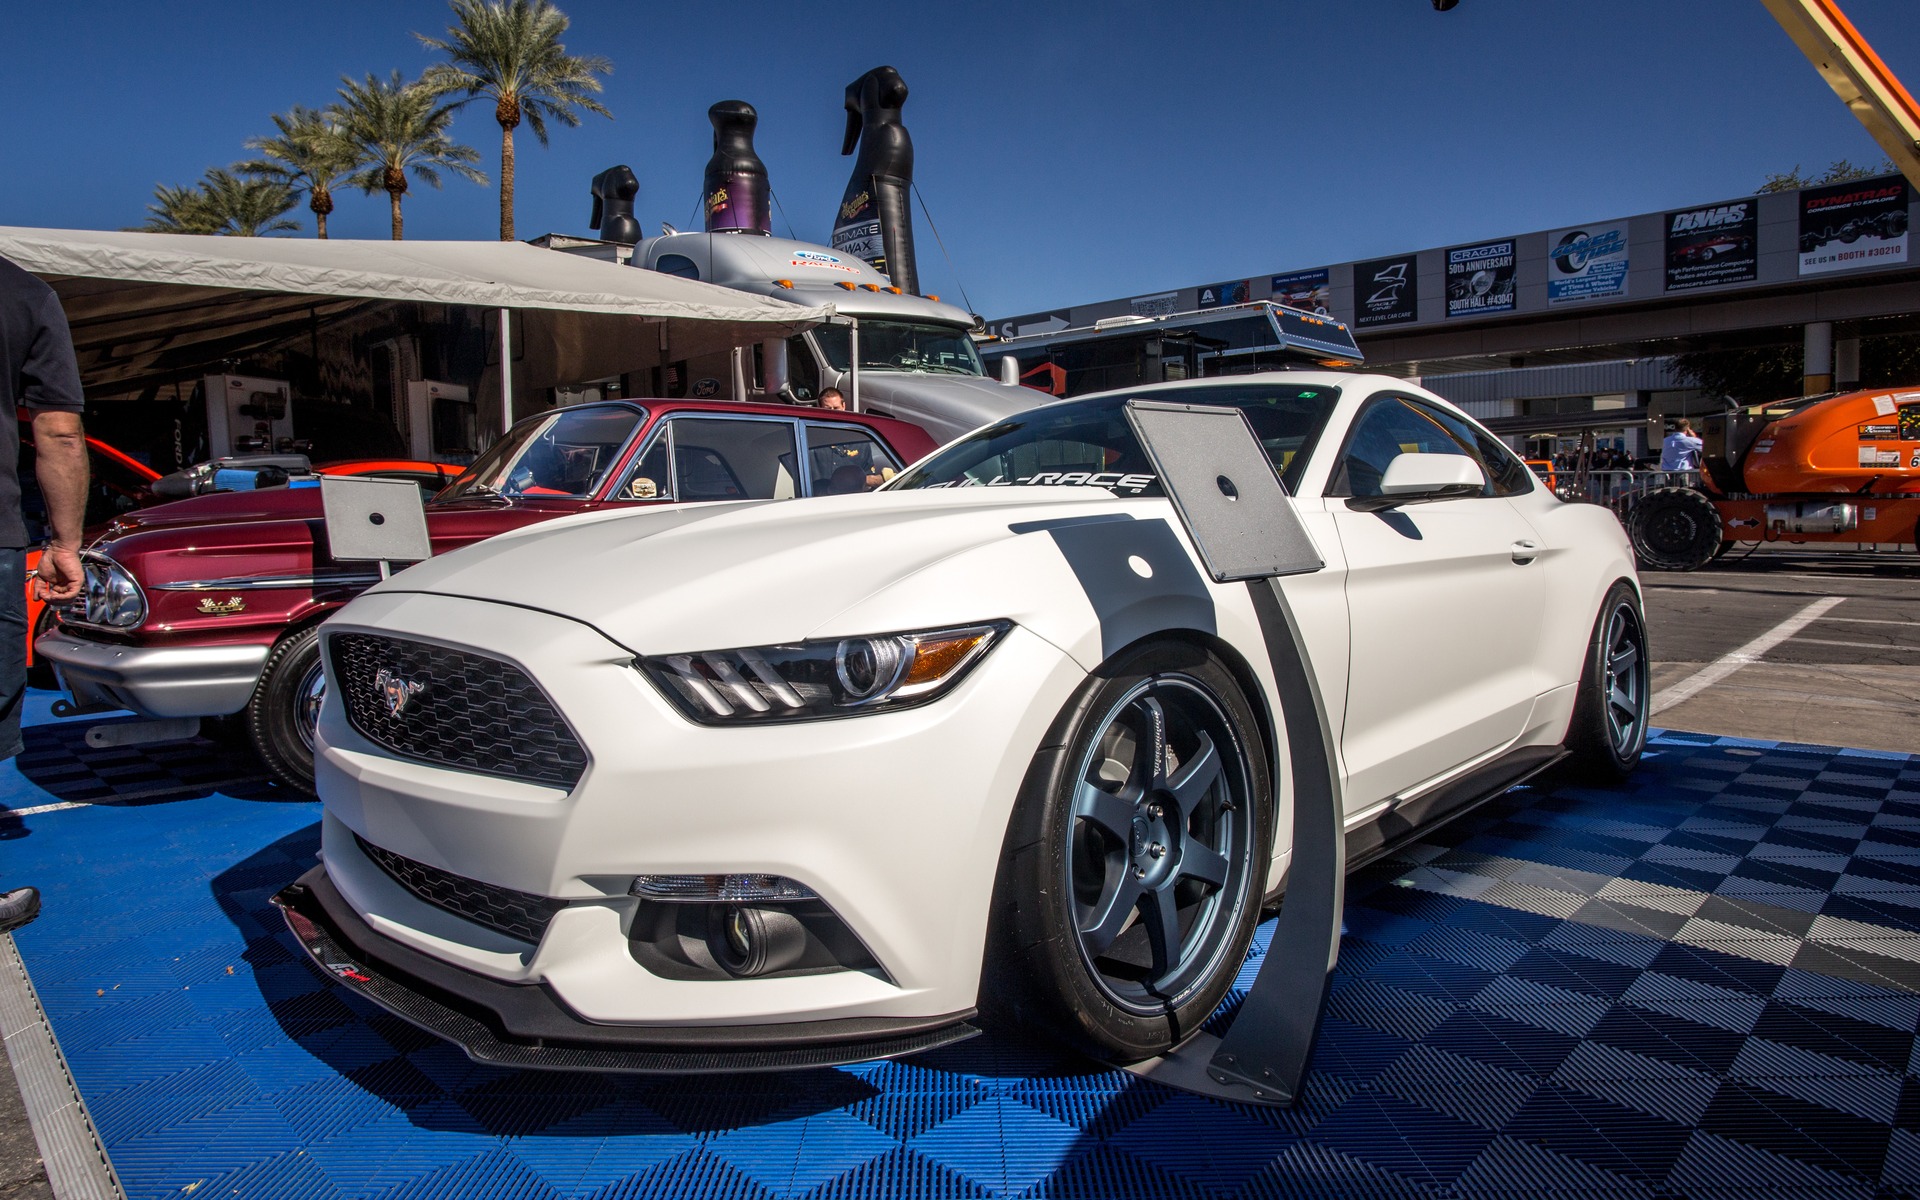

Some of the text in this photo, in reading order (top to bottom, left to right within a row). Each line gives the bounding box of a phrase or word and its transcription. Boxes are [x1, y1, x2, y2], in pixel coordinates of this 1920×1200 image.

[1806, 185, 1902, 208] DYNATRAC
[1807, 203, 1852, 214] CONFIDENCE
[1862, 195, 1897, 205] EXPLORE
[1671, 203, 1748, 233] DOWNS
[844, 239, 873, 255] WAX
[1453, 246, 1507, 260] CRAGAR
[1550, 229, 1621, 259] COKER
[1576, 238, 1627, 263] TIRE
[1804, 257, 1816, 265] SEE
[1828, 254, 1836, 262] IN
[1838, 250, 1865, 261] BOOTH
[1867, 245, 1901, 257] #30210
[1448, 255, 1514, 275] 50th ANNIVERSARY
[1668, 258, 1755, 276] High Performance Composite
[1674, 273, 1696, 281] Bodies
[1707, 266, 1747, 277] Components
[1575, 276, 1597, 284] Largest
[1597, 272, 1623, 281] Supplier
[1567, 288, 1593, 296] Collector
[1592, 285, 1618, 293] Vehicles
[1367, 300, 1399, 308] EAGLE
[1371, 304, 1393, 312] ONE
[1449, 298, 1470, 311] SOUTH
[1470, 296, 1487, 308] HALL
[1487, 293, 1514, 306] #43047
[1359, 311, 1412, 323] NEXT LEVEL CAR CARE
[696, 381, 716, 396] Ford
[174, 418, 183, 465] FORD
